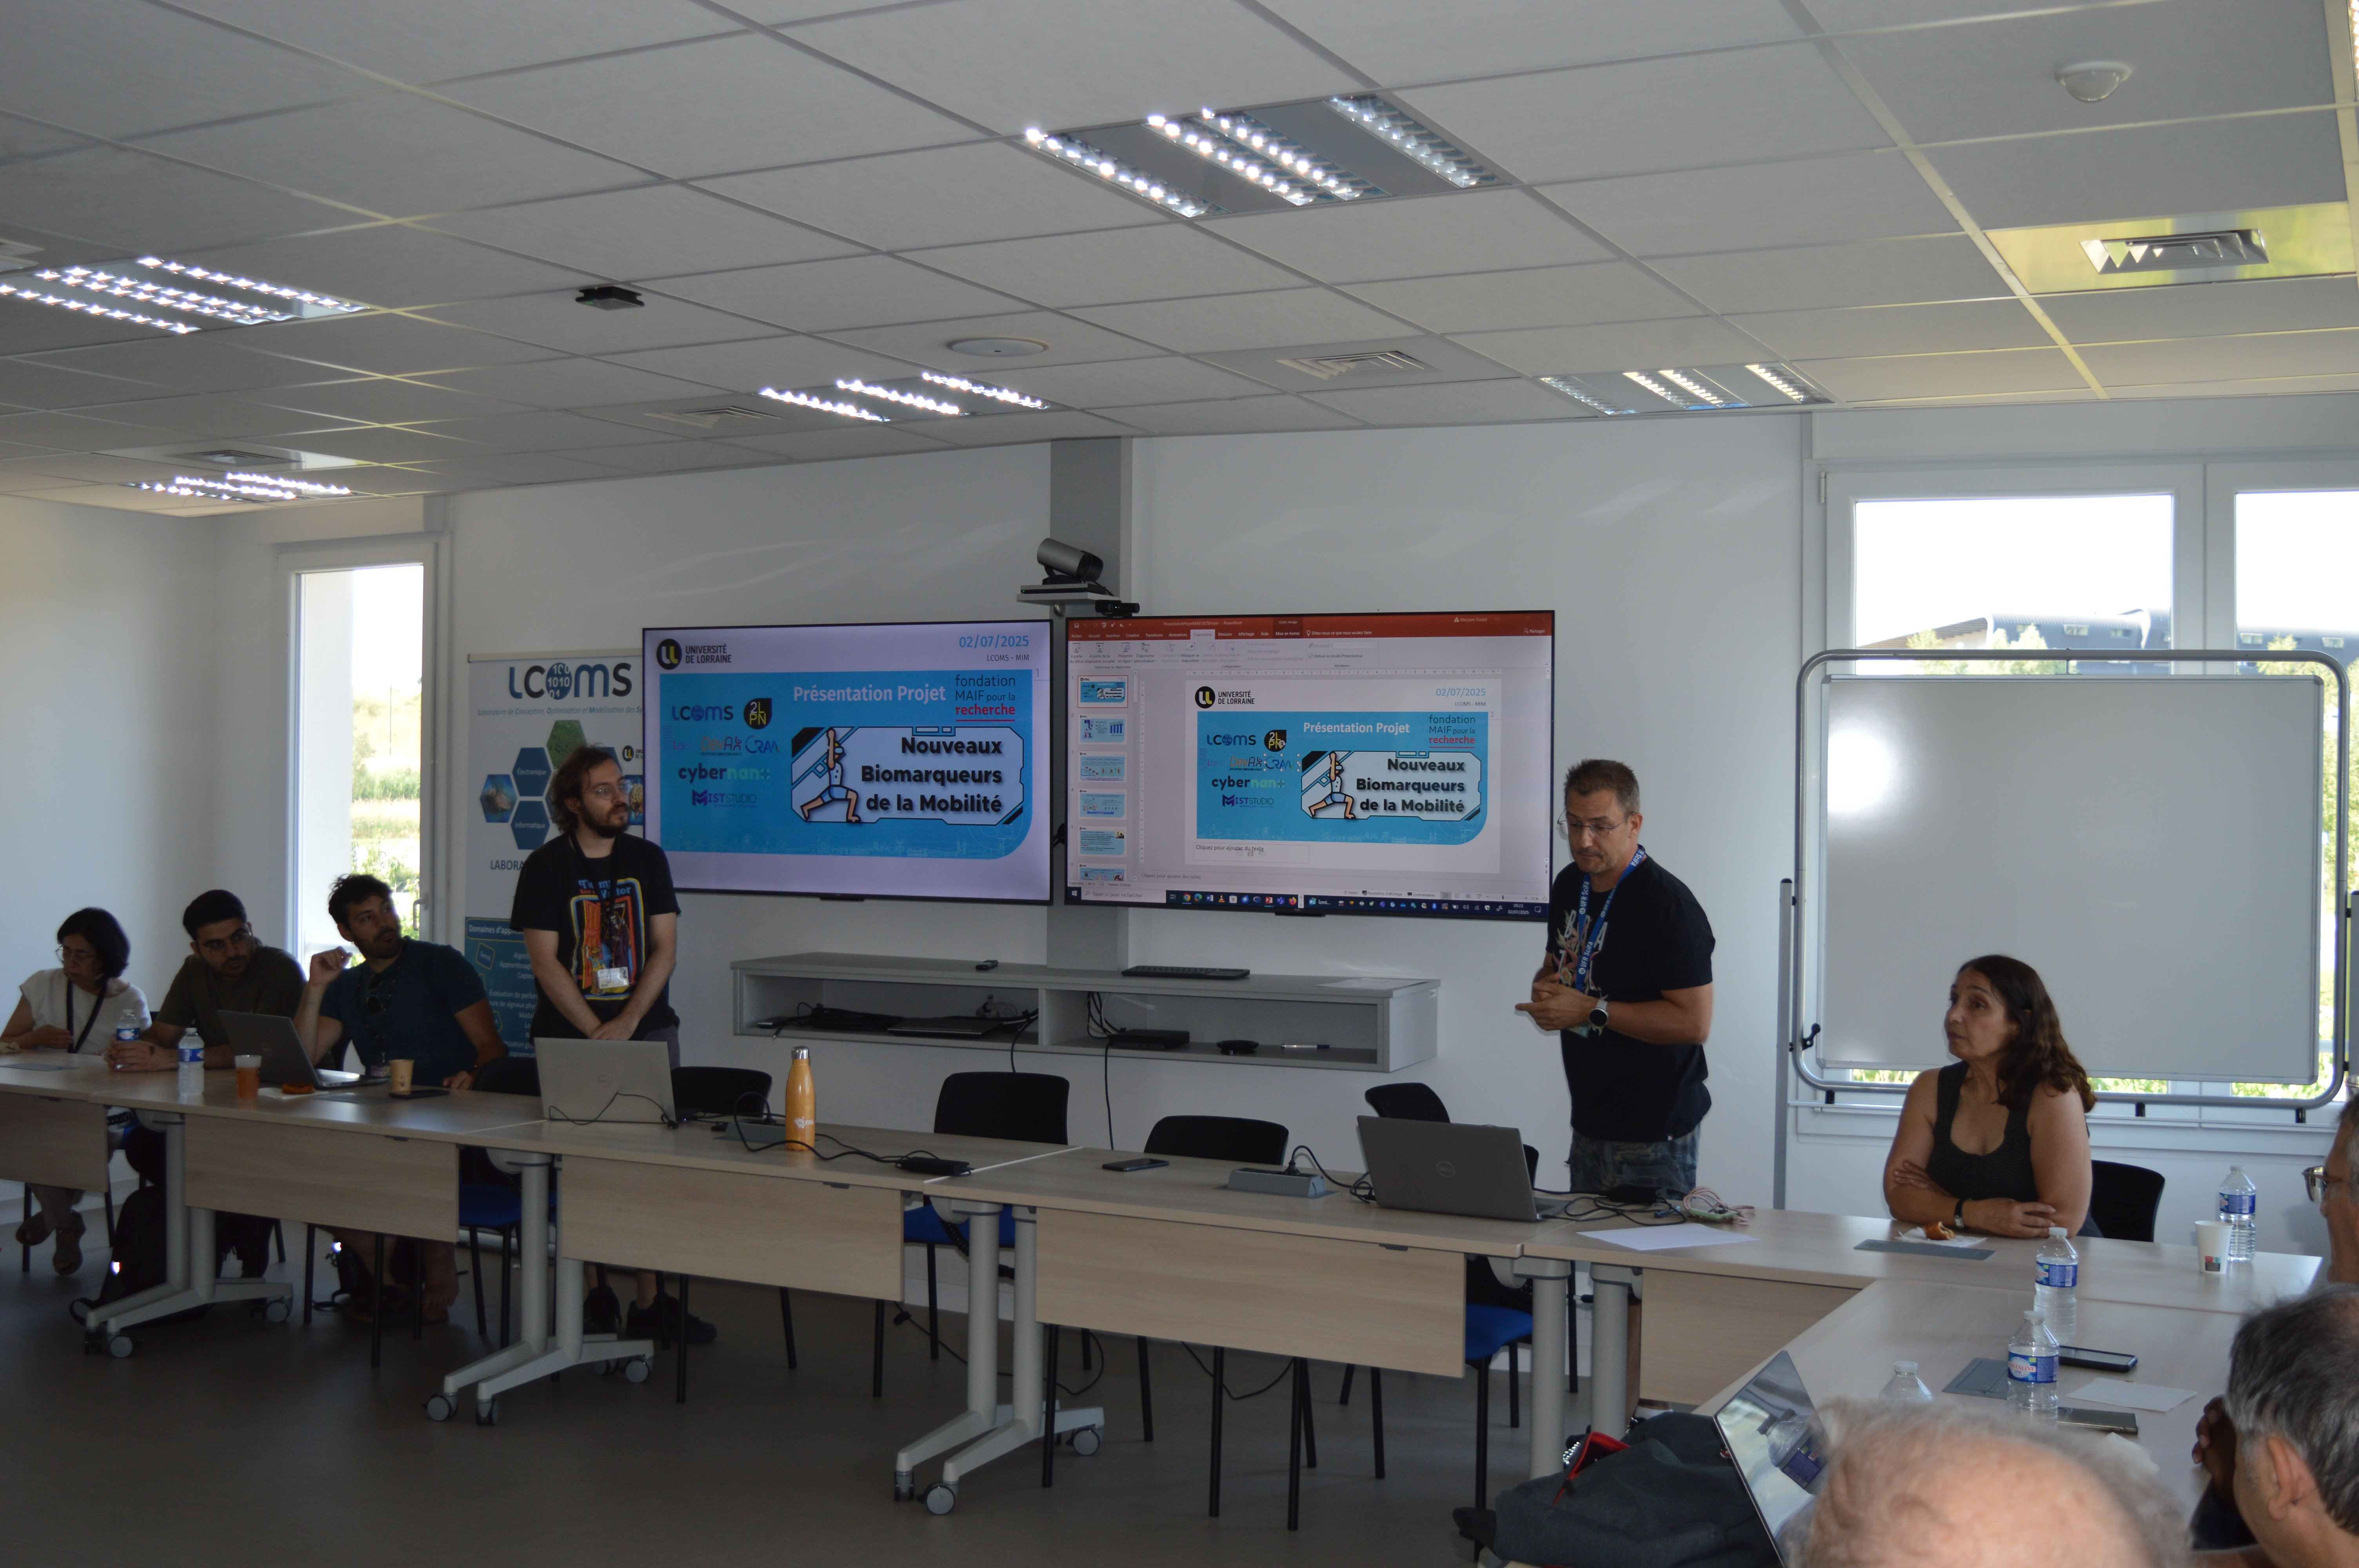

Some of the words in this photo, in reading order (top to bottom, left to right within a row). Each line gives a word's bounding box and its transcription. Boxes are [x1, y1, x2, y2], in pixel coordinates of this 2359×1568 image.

[959, 635, 1029, 648] 02/07/2025
[686, 643, 727, 654] UNIVERSITÉ
[686, 655, 694, 663] DE
[697, 655, 732, 663] LORRAINE
[1035, 668, 1039, 677] 1
[955, 674, 1016, 686] fondation
[794, 684, 892, 701] Présentation
[898, 683, 946, 704] Projet
[956, 690, 984, 701] MAIF
[987, 694, 1006, 702] pour
[1009, 692, 1015, 701] la
[1436, 688, 1486, 697] 02/07/2025
[515, 708, 545, 717] Conception,
[956, 703, 1015, 715] recherche
[1429, 715, 1475, 724] fondation
[1304, 722, 1372, 733] Présentation
[1376, 722, 1410, 735] Projet
[901, 737, 1002, 754] Nouveaux
[1429, 735, 1475, 744] recherche
[1387, 758, 1465, 771] Nouveaux
[517, 767, 547, 776] Électronique
[861, 764, 1003, 786] Biomarqueurs
[1356, 777, 1465, 793] Biomarqueurs
[866, 794, 891, 811] de
[897, 794, 913, 811] la
[920, 793, 1002, 812] Mobilité
[1359, 799, 1379, 811] de
[1383, 799, 1396, 811] la
[1401, 798, 1465, 812] Mobilité
[1582, 881, 1590, 895] SciFA
[469, 925, 495, 934] Domaines
[1584, 941, 1594, 956] SciFA
[490, 989, 513, 997] Évaluation
